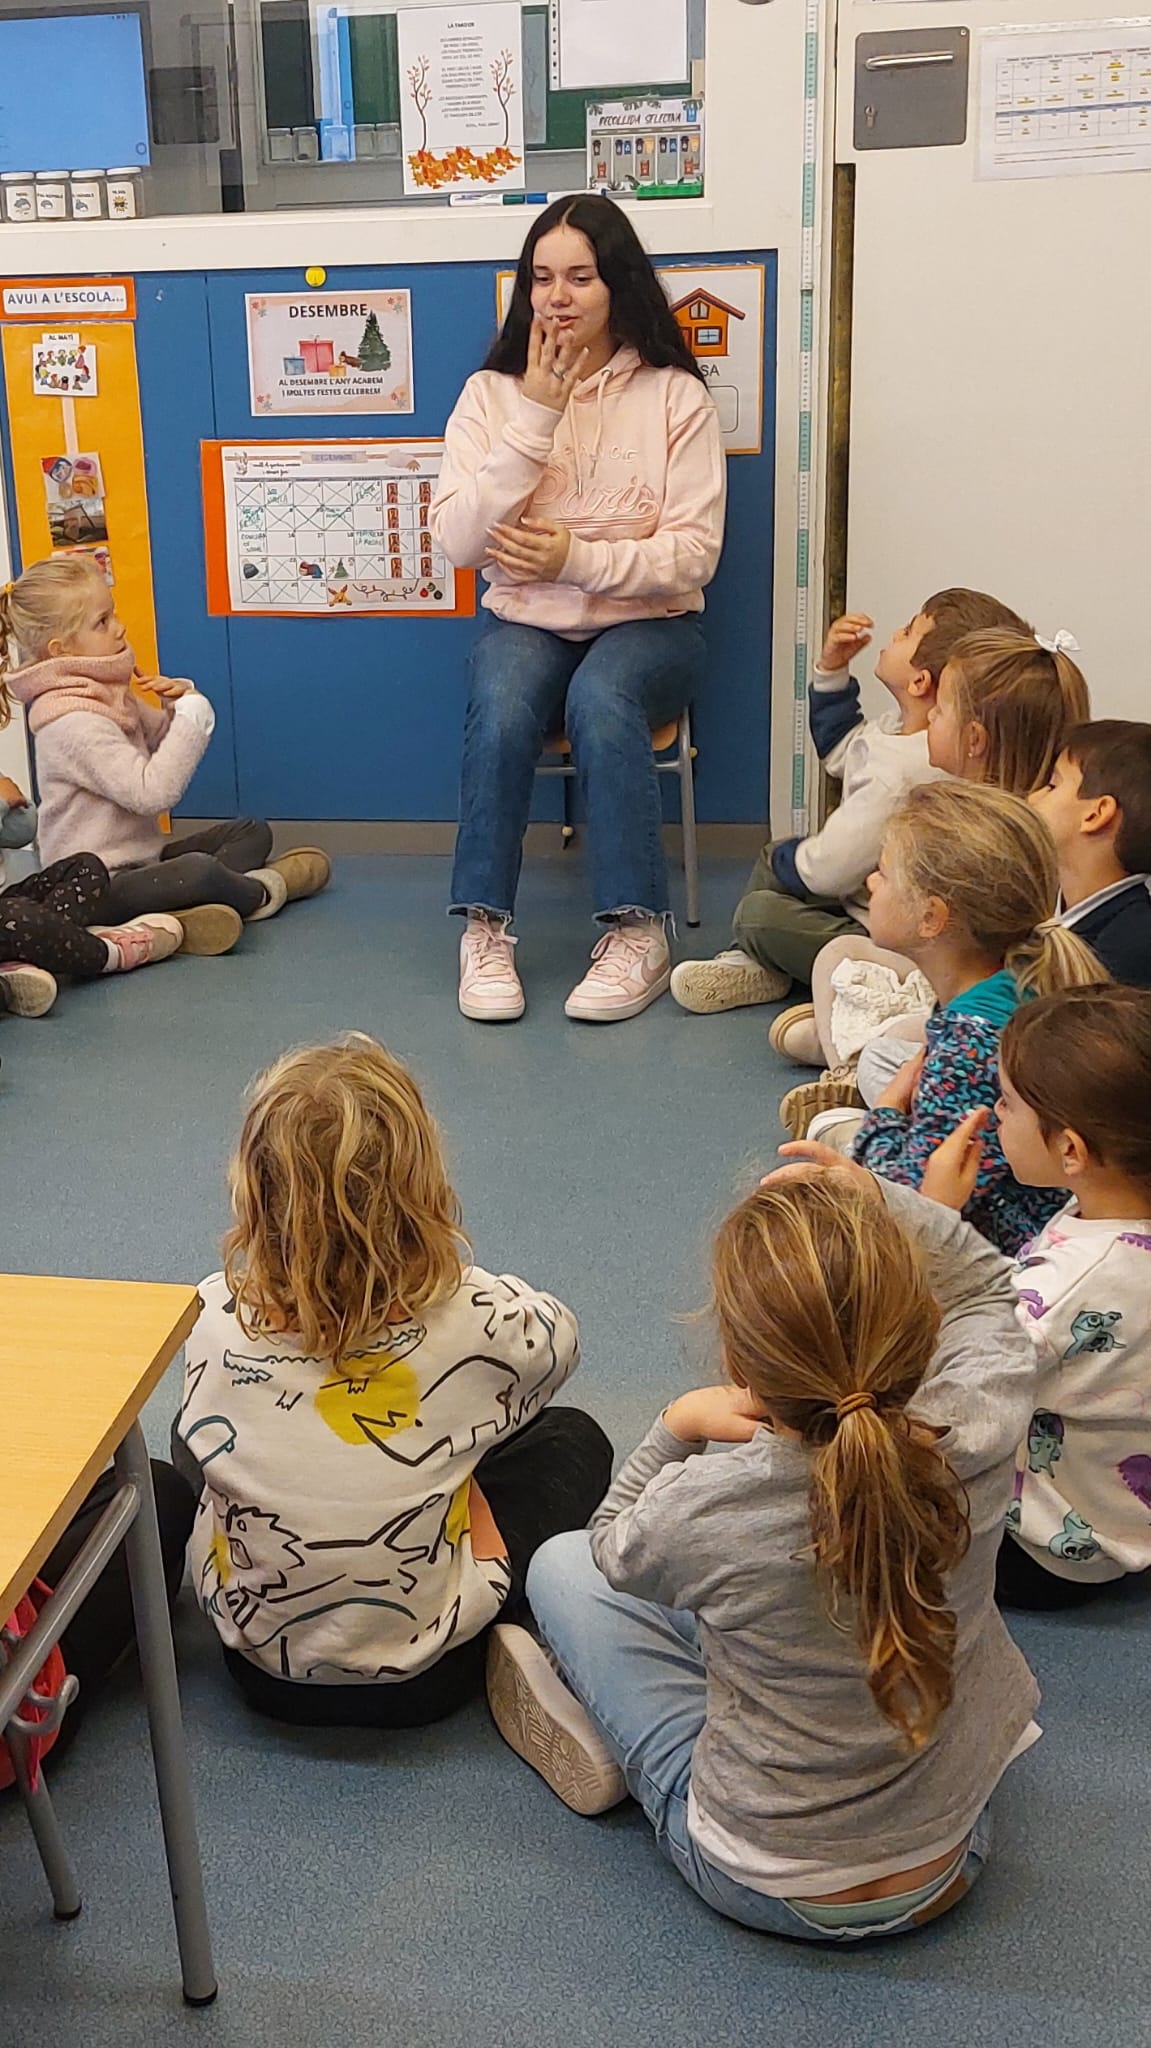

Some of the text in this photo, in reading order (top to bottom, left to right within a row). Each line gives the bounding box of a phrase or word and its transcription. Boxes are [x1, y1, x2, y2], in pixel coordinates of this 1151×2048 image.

[7, 291, 124, 304] AVUI A L'ESCOLA...
[289, 303, 368, 318] DESEMBRE
[700, 364, 720, 377] SA
[290, 378, 328, 386] DESEMBRE
[329, 377, 352, 385] L'ANY
[286, 389, 315, 397] MOLTES
[317, 388, 341, 396] FESTES
